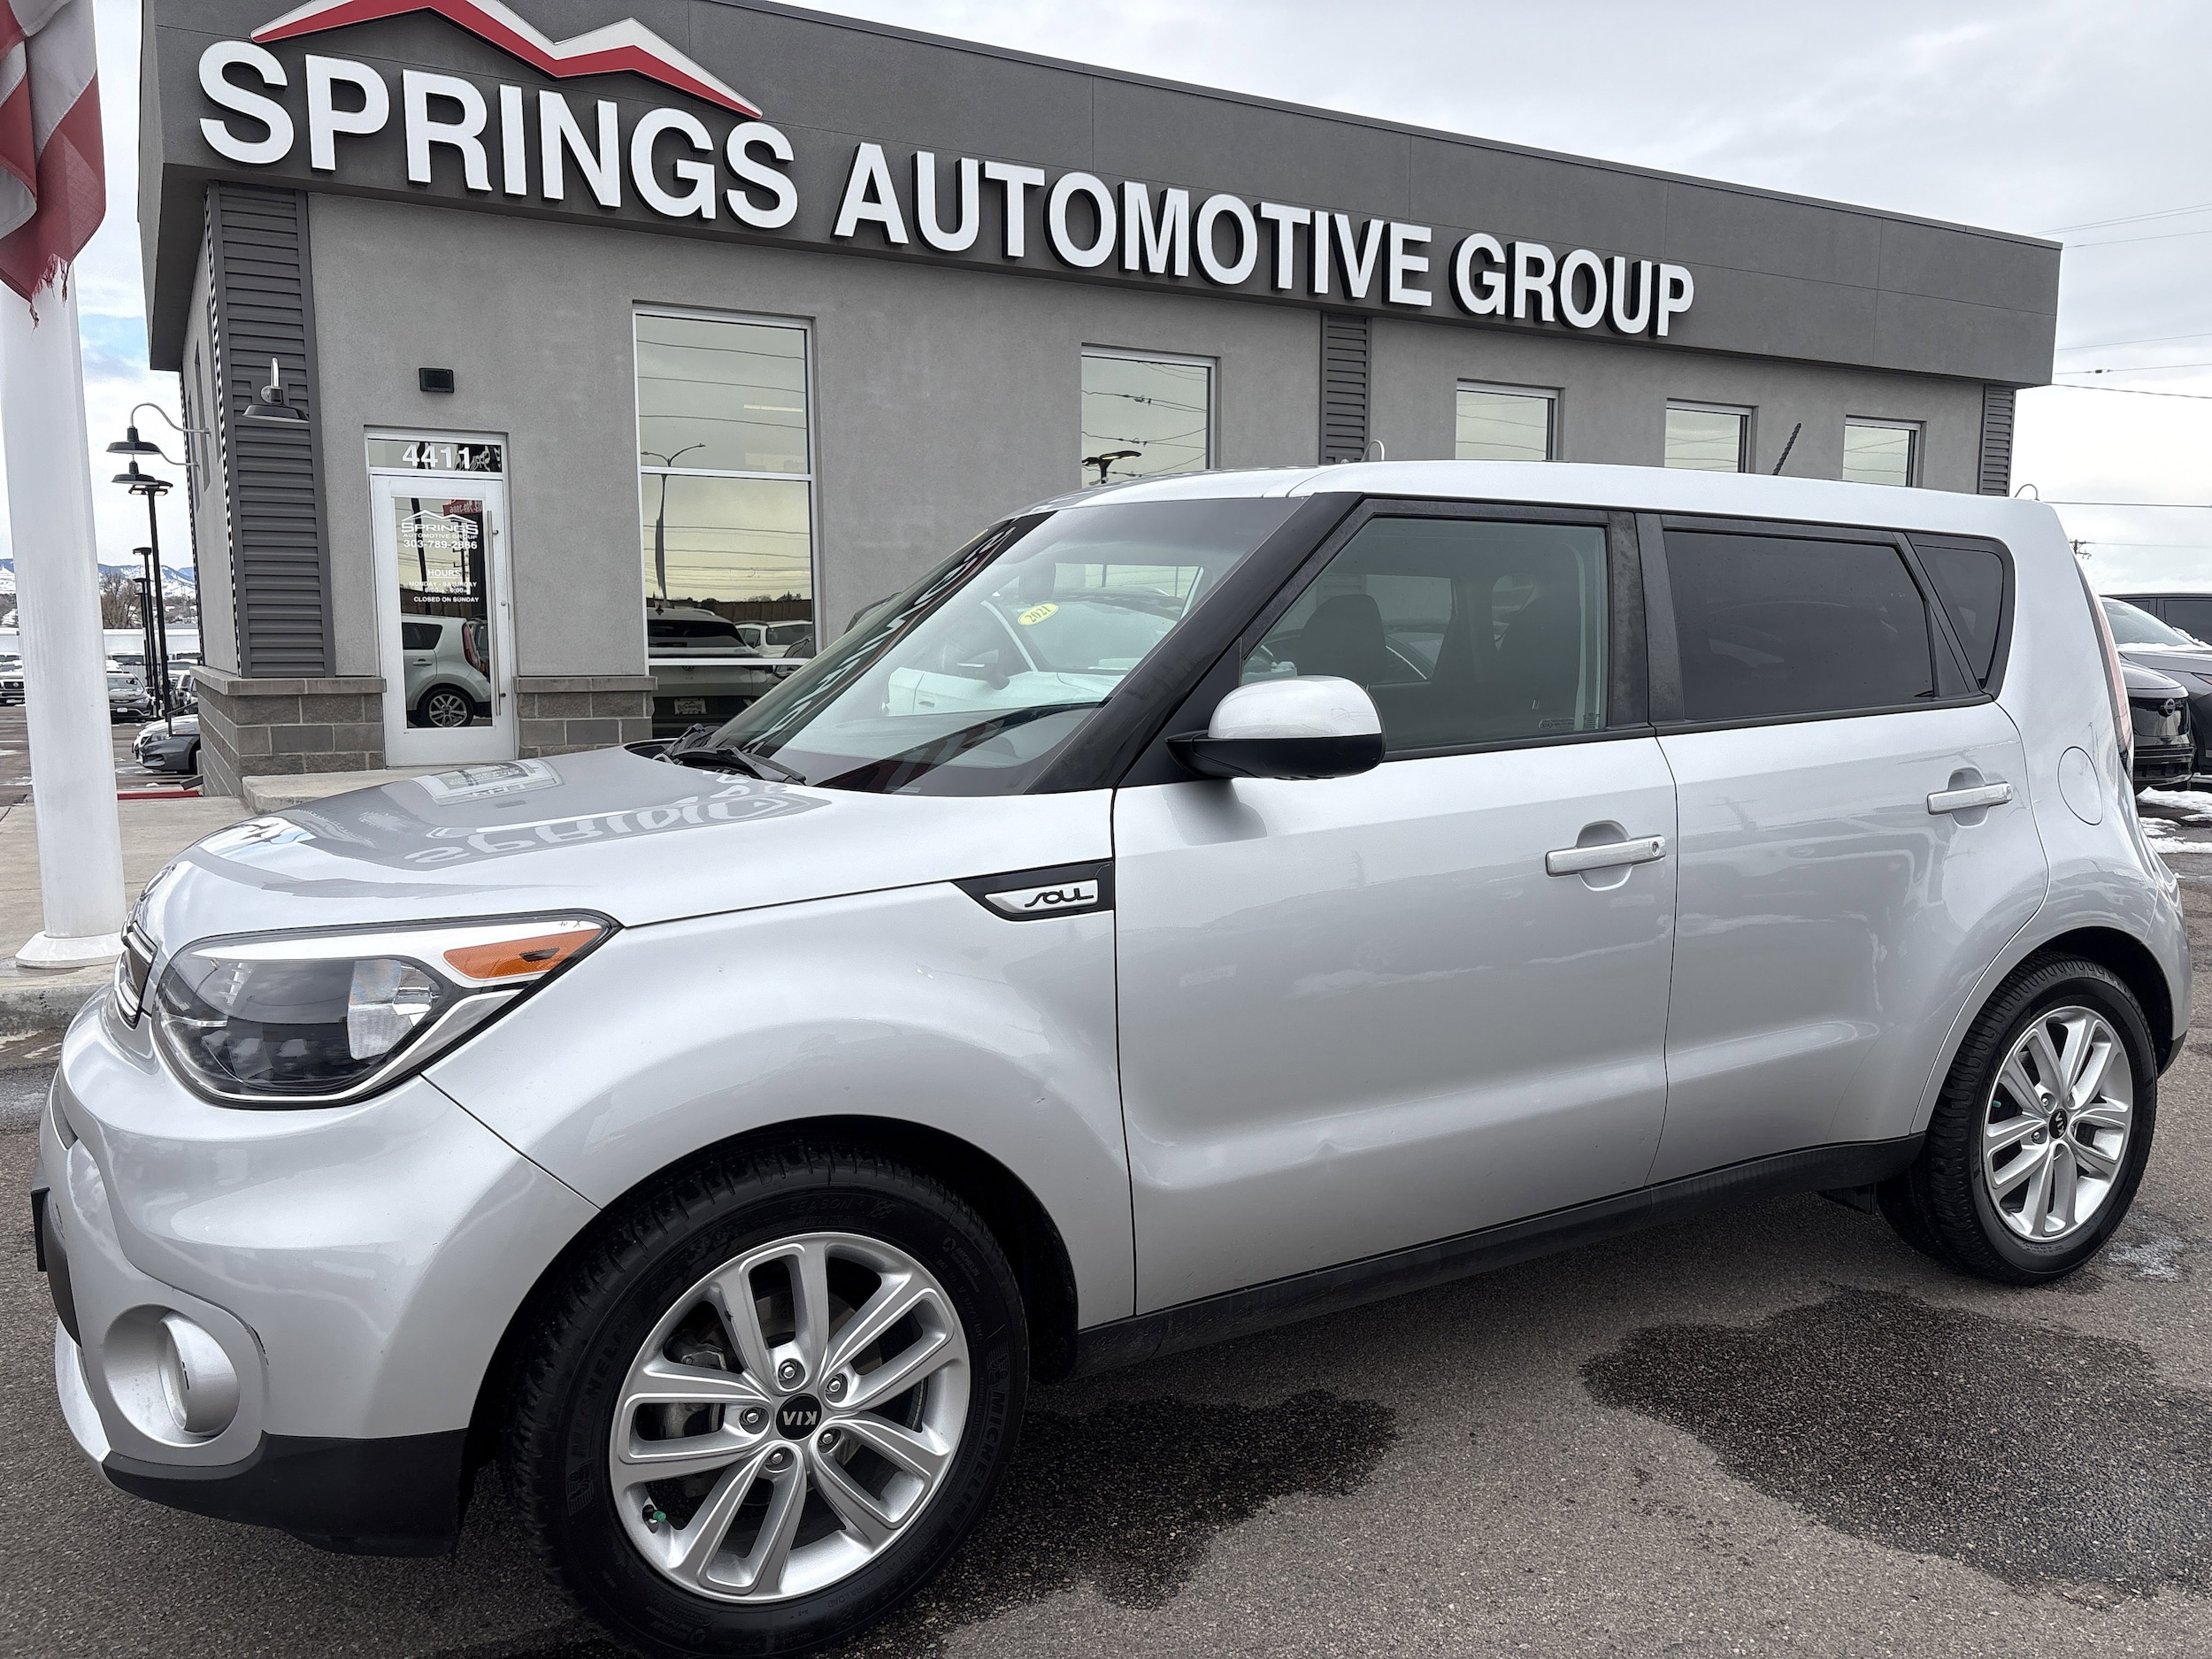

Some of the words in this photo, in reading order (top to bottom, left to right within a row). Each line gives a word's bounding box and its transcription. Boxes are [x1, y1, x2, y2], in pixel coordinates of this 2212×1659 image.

[198, 40, 799, 230] SPRINGS
[834, 142, 1432, 307] AUTOMOTIVE
[1452, 232, 1694, 338] GROUP
[402, 444, 471, 469] 4411
[401, 522, 479, 535] SPRINGS
[403, 539, 478, 549] 303-789-2886
[1025, 605, 1053, 623] 2021
[1024, 887, 1094, 908] SOUL
[2055, 1111, 2065, 1137] KIA
[782, 1410, 818, 1426] KIA
